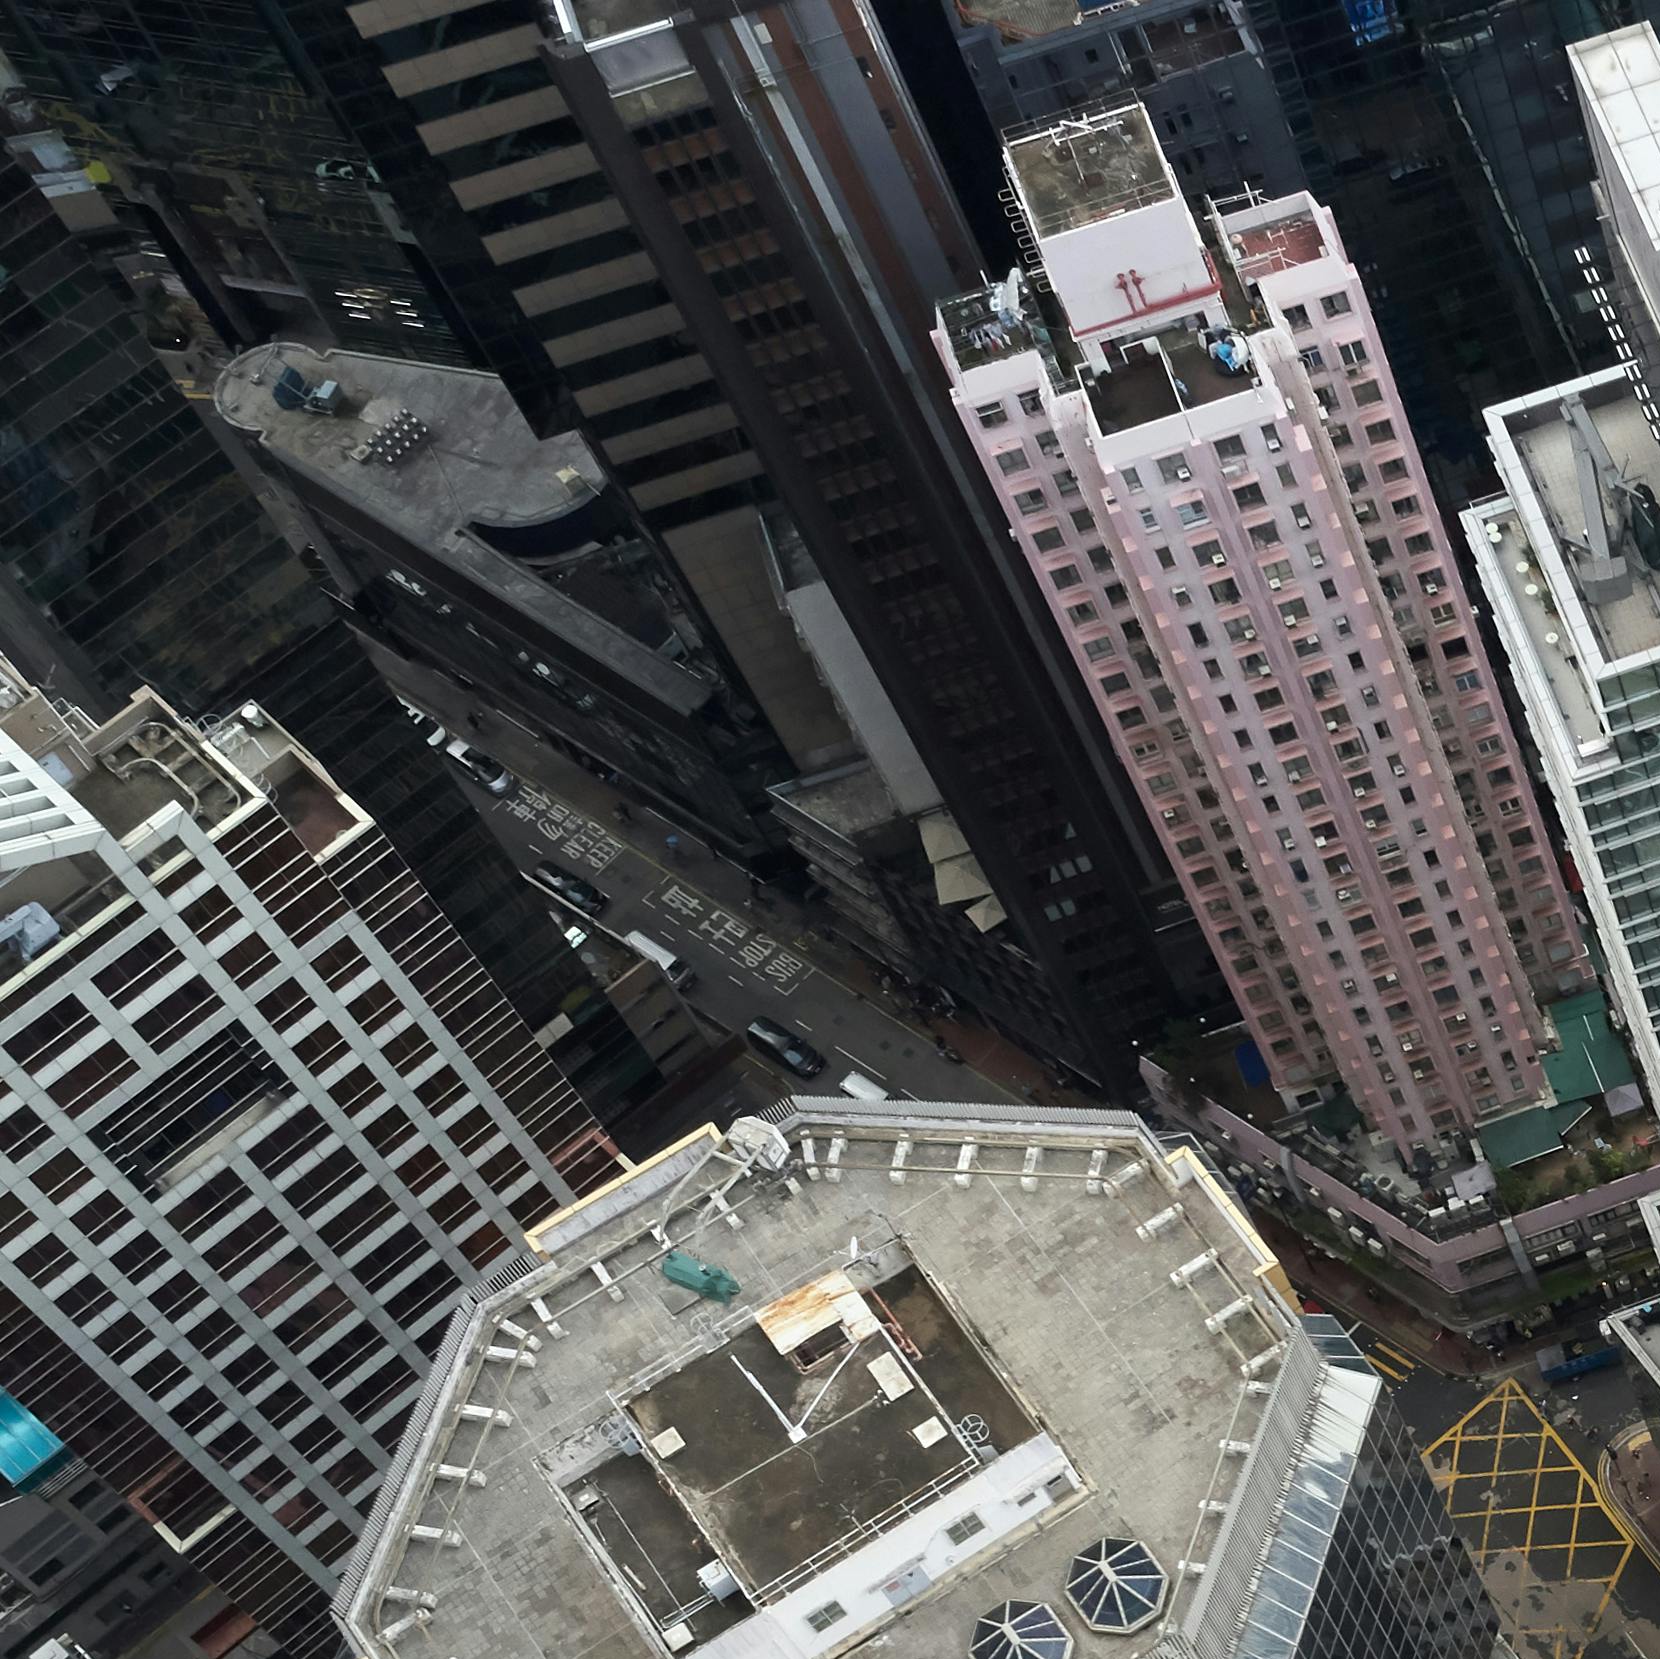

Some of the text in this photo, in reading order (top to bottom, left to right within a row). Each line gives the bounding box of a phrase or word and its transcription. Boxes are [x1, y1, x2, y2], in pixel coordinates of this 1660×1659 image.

[505, 785, 552, 823] 停車
[536, 804, 584, 841] 請勿
[560, 821, 606, 860] CLEAR
[586, 836, 623, 869] KEEP
[661, 884, 704, 918] 站
[699, 910, 749, 947] 巴士
[738, 933, 777, 968] STOP
[764, 952, 803, 982] BUS
